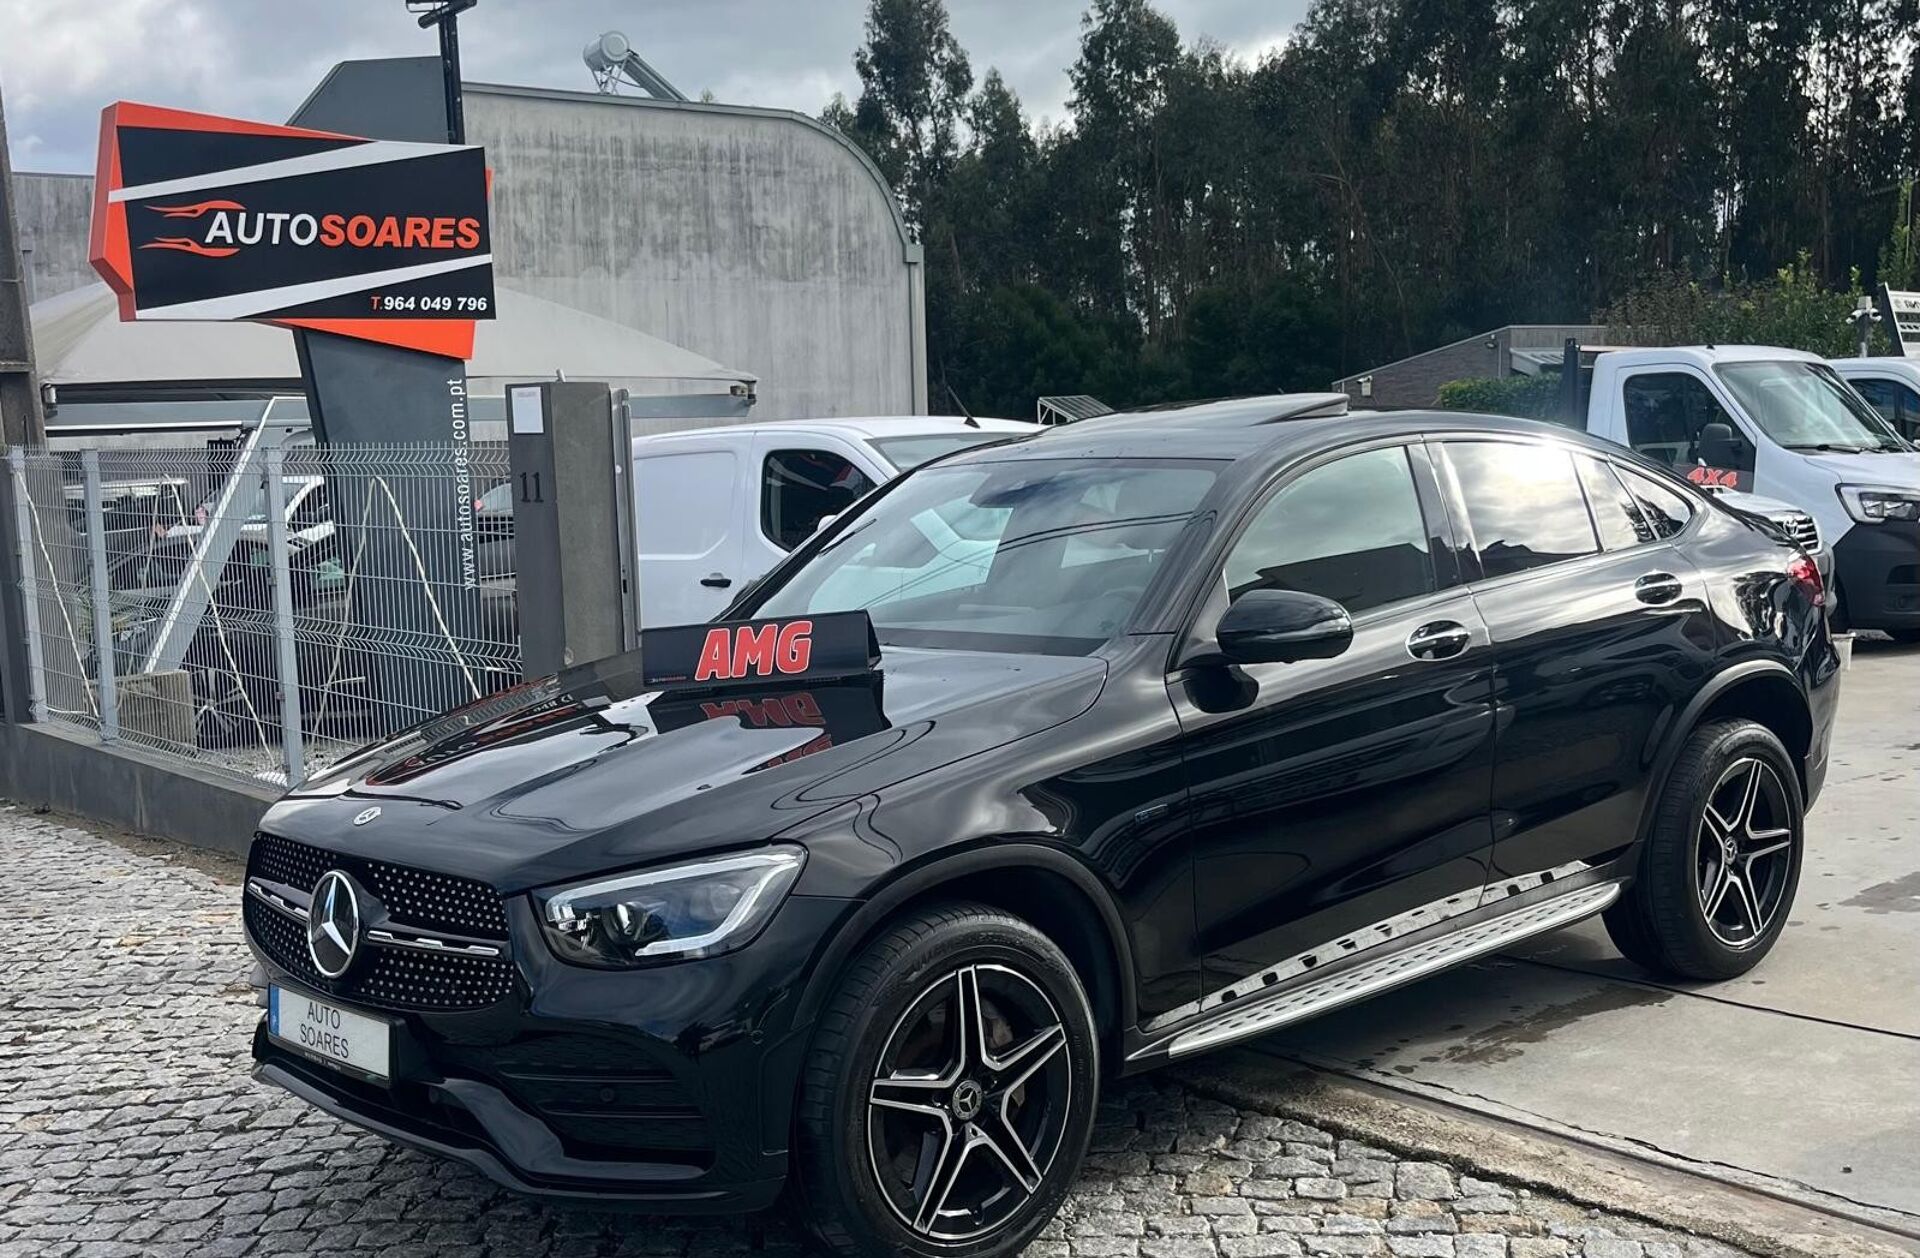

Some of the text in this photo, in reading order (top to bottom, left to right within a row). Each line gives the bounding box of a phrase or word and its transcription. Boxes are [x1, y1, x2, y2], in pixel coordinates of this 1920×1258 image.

[204, 211, 480, 249] AUTOSOARES
[420, 296, 452, 311] 049
[456, 297, 488, 311] 796
[447, 378, 476, 591] www.autosoares.com.pt
[519, 471, 545, 503] 11
[695, 620, 813, 681] AMG
[306, 1001, 341, 1030] AUTO
[300, 1023, 350, 1059] SOARES
